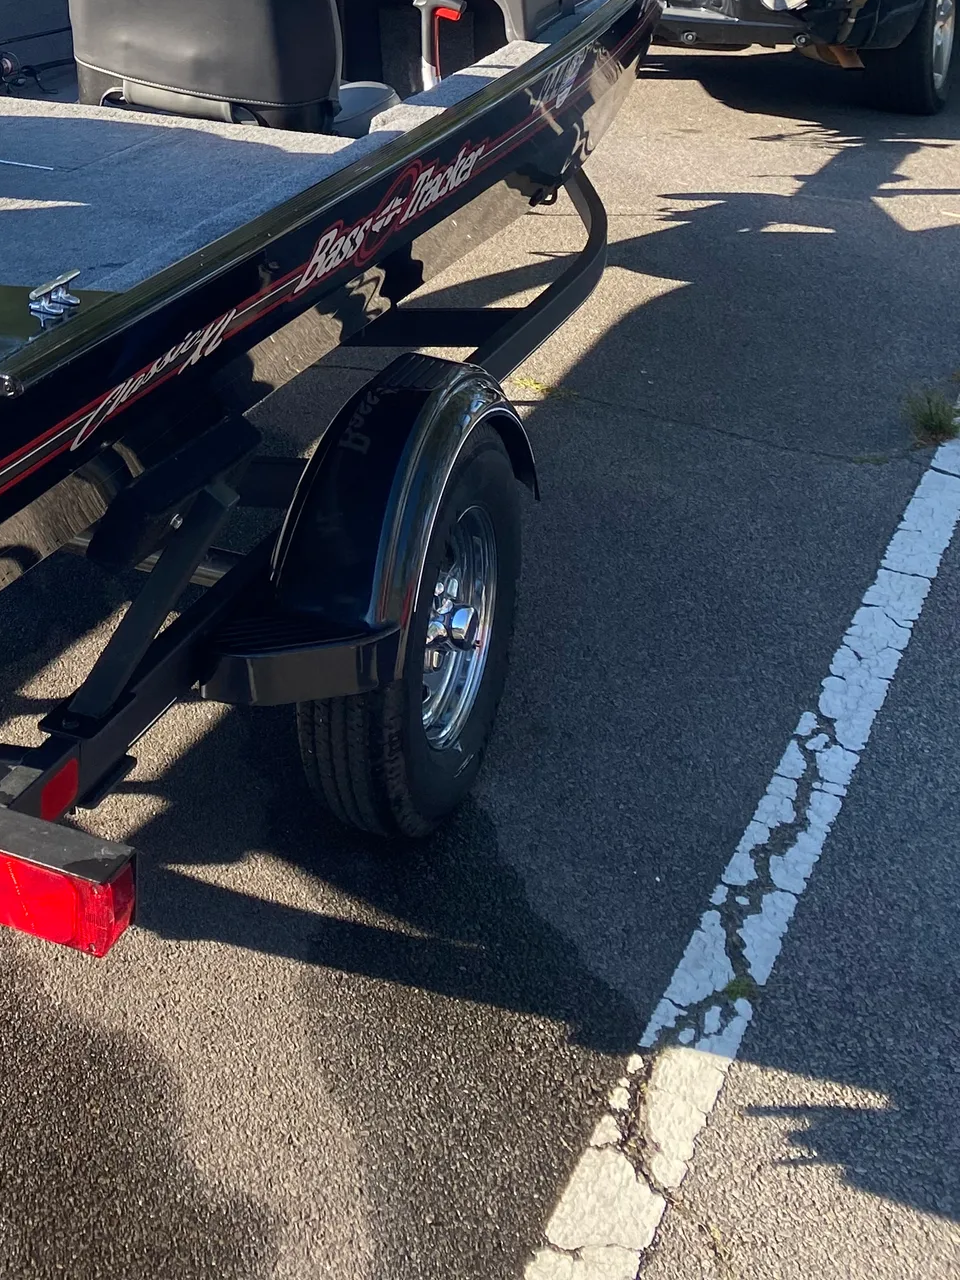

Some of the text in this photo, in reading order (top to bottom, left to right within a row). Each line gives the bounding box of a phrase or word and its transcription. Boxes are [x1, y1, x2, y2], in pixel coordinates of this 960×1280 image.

[293, 145, 485, 293] Bass Tracker
[70, 329, 205, 452] Classic
